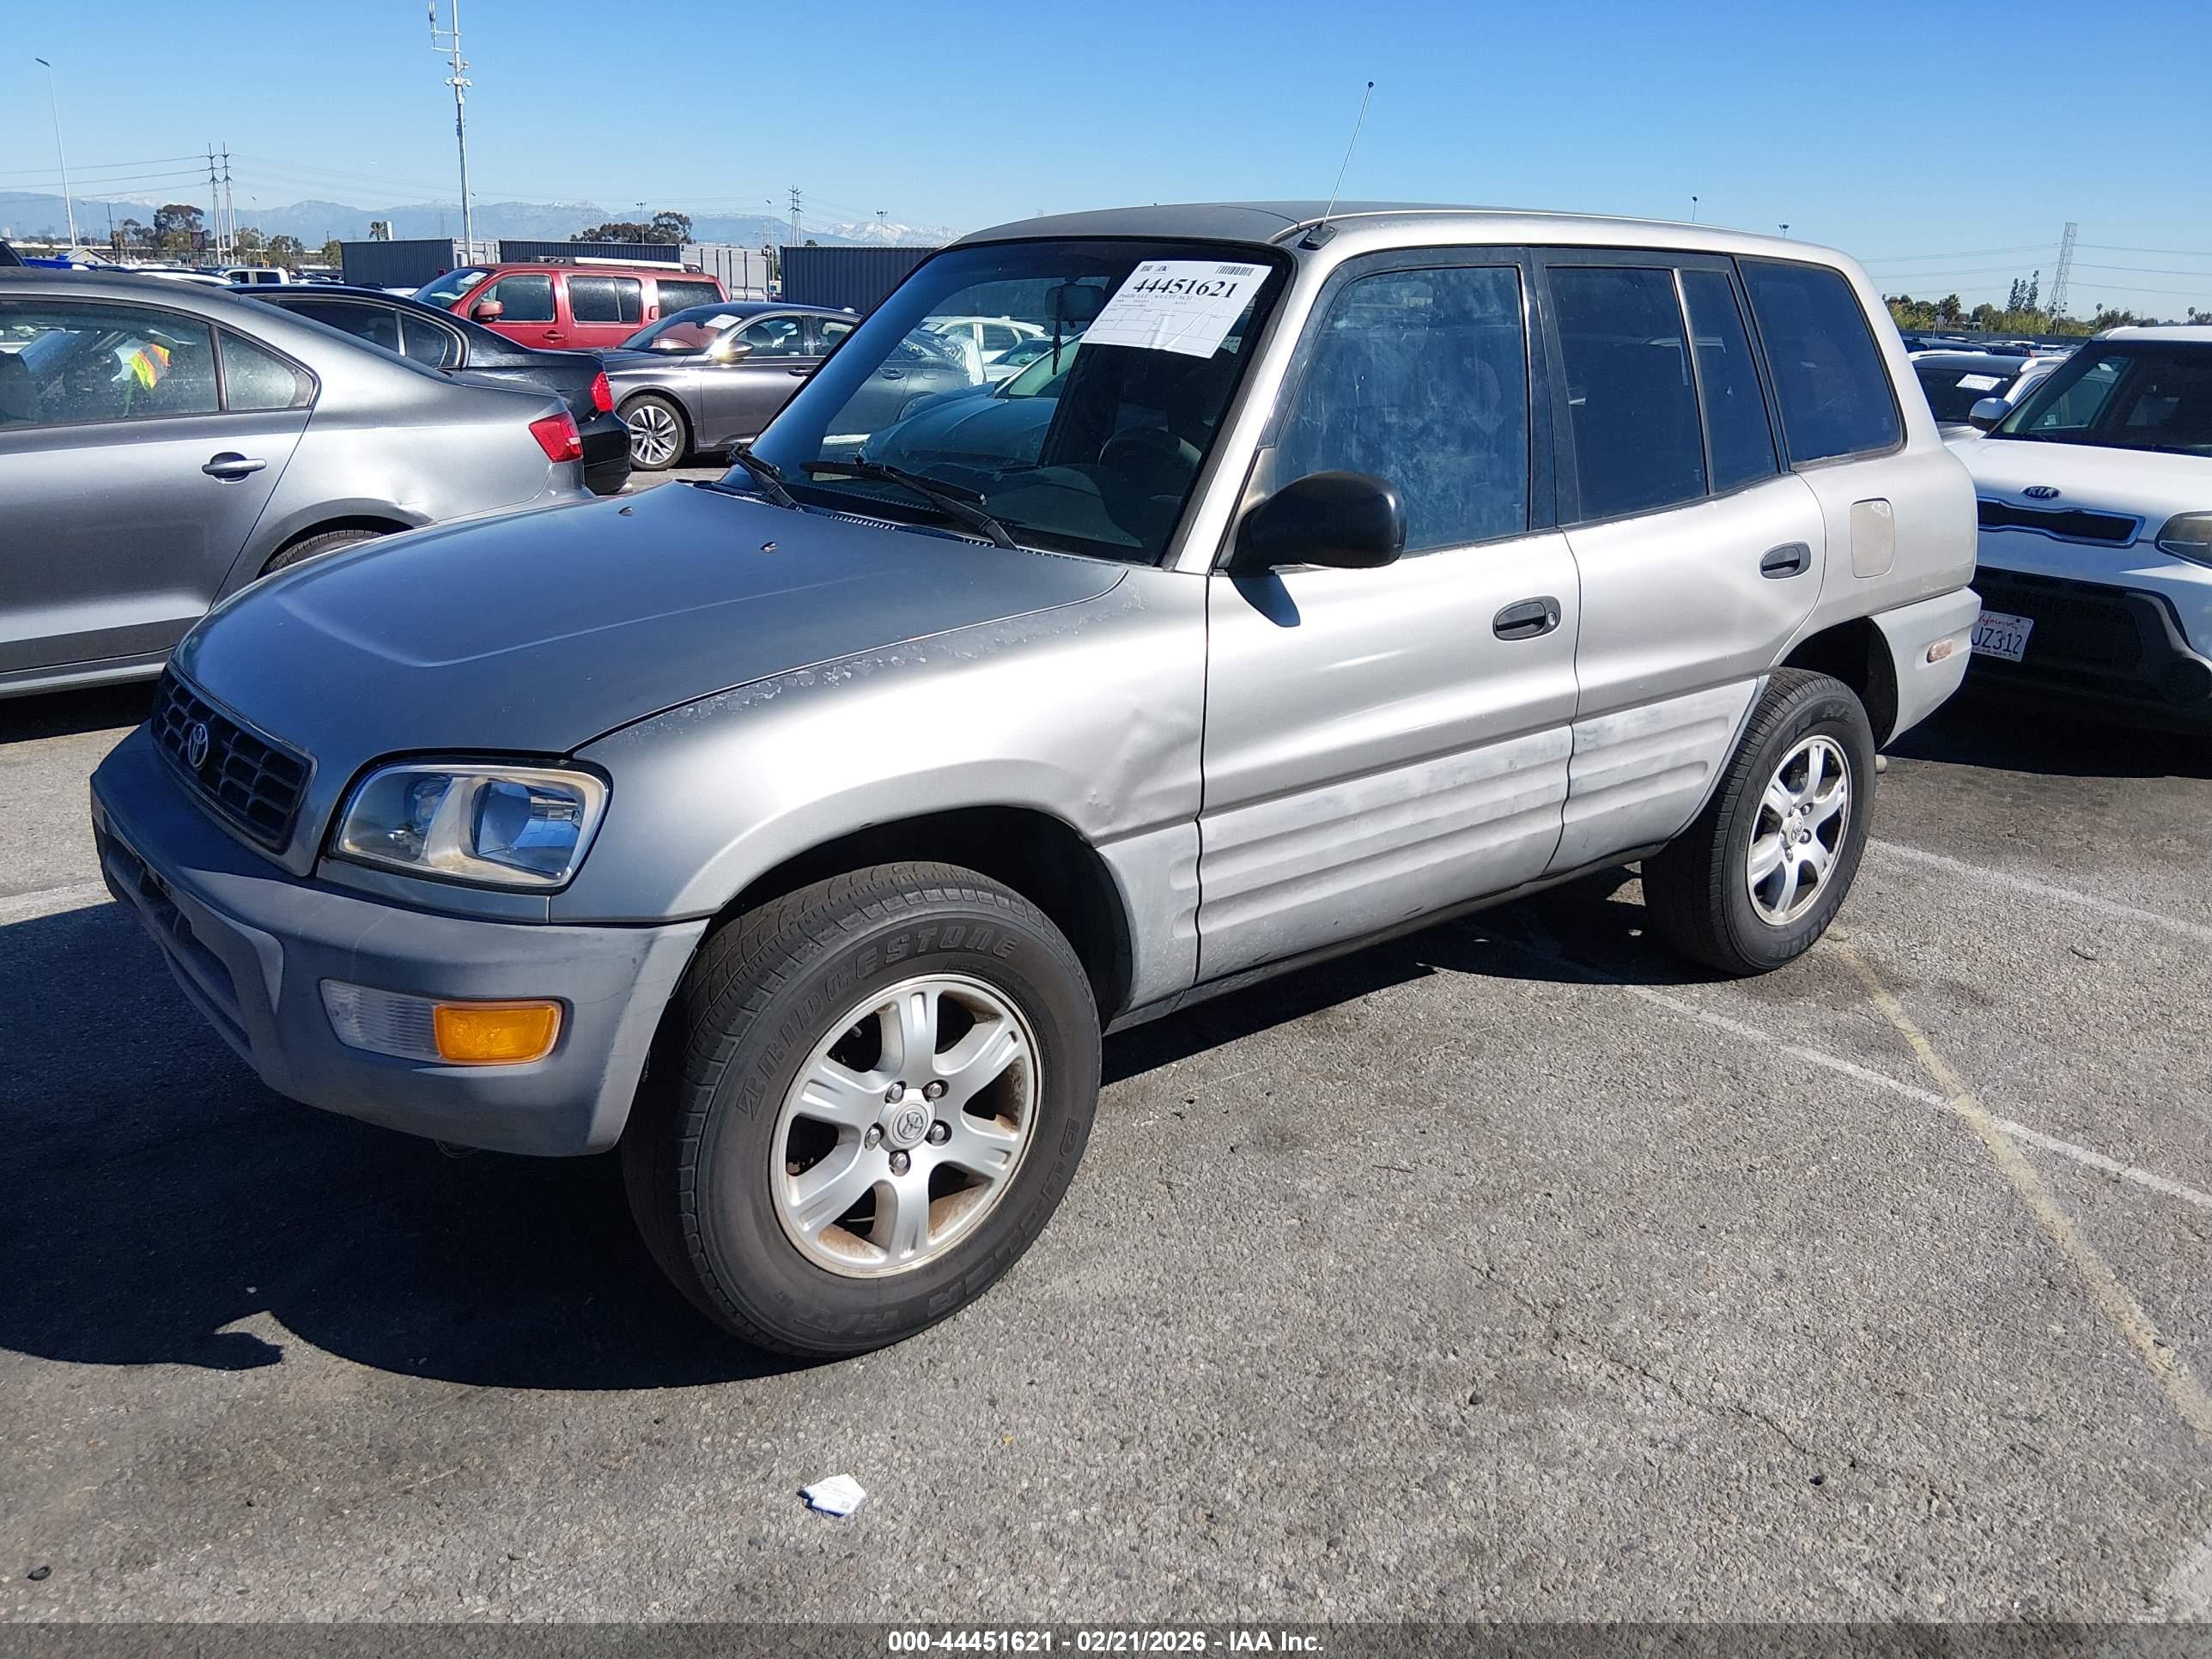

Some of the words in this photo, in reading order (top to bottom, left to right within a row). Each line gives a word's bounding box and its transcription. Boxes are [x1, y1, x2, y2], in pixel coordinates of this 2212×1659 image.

[1133, 278, 1238, 298] 44451621
[2027, 487, 2055, 499] KIA
[736, 926, 1018, 1121] BRIDGESTONE
